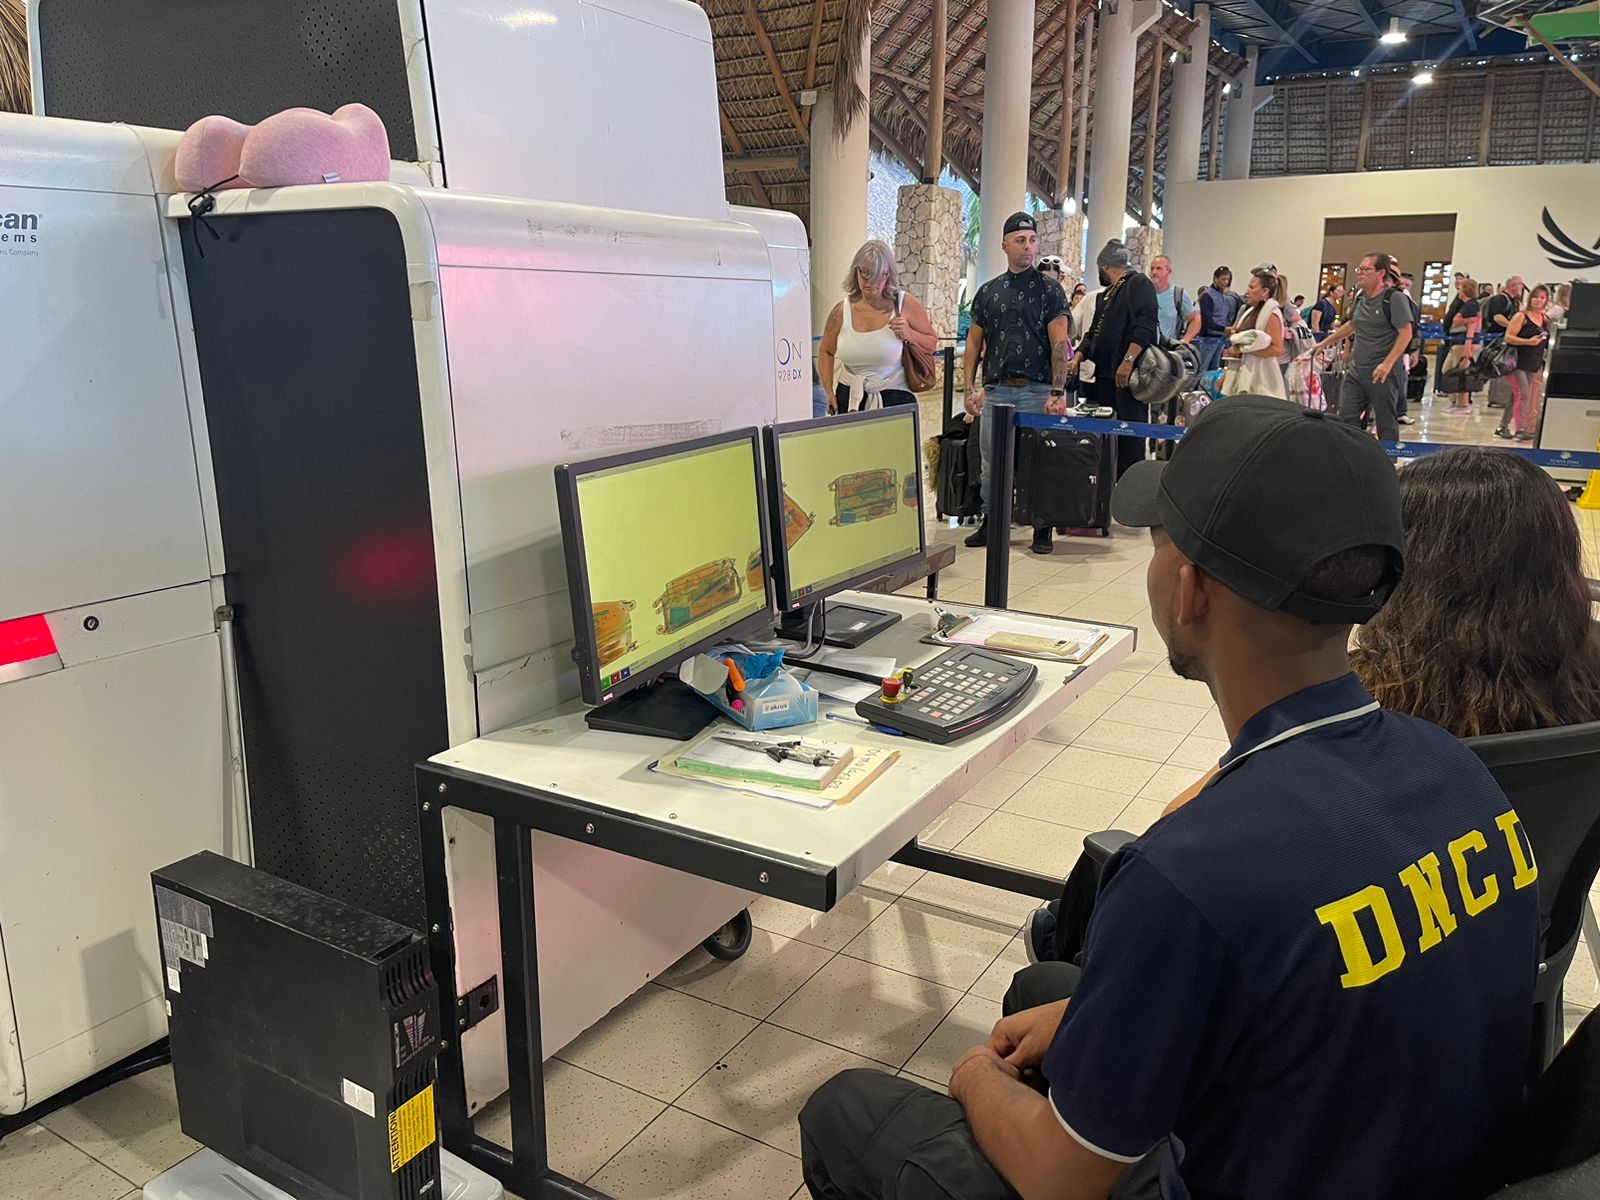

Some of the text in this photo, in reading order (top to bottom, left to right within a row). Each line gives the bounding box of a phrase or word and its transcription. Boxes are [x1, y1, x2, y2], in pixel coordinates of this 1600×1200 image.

[9, 248, 39, 257] Company
[778, 369, 802, 381] 928 DX
